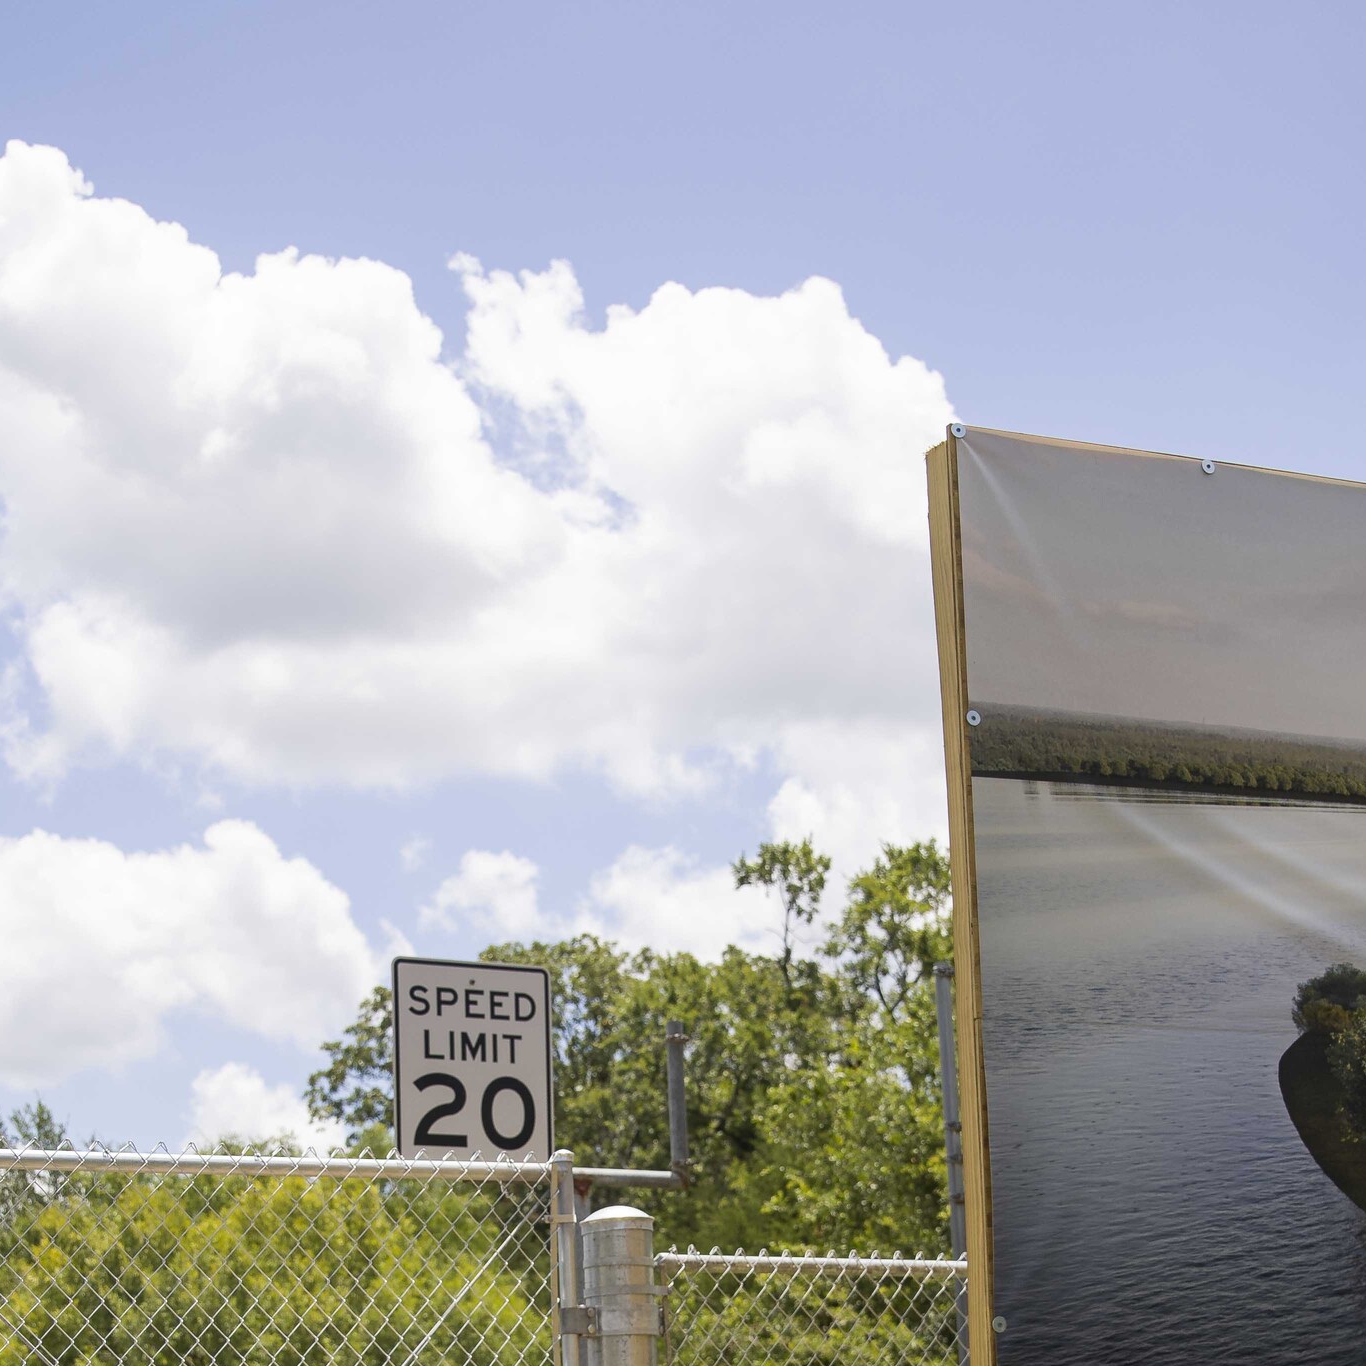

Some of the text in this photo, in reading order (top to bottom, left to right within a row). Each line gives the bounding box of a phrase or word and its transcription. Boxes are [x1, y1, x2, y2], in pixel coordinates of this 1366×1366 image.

[408, 985, 536, 1022] SPEED
[424, 1029, 522, 1064] LIMIT
[413, 1072, 536, 1151] 20
